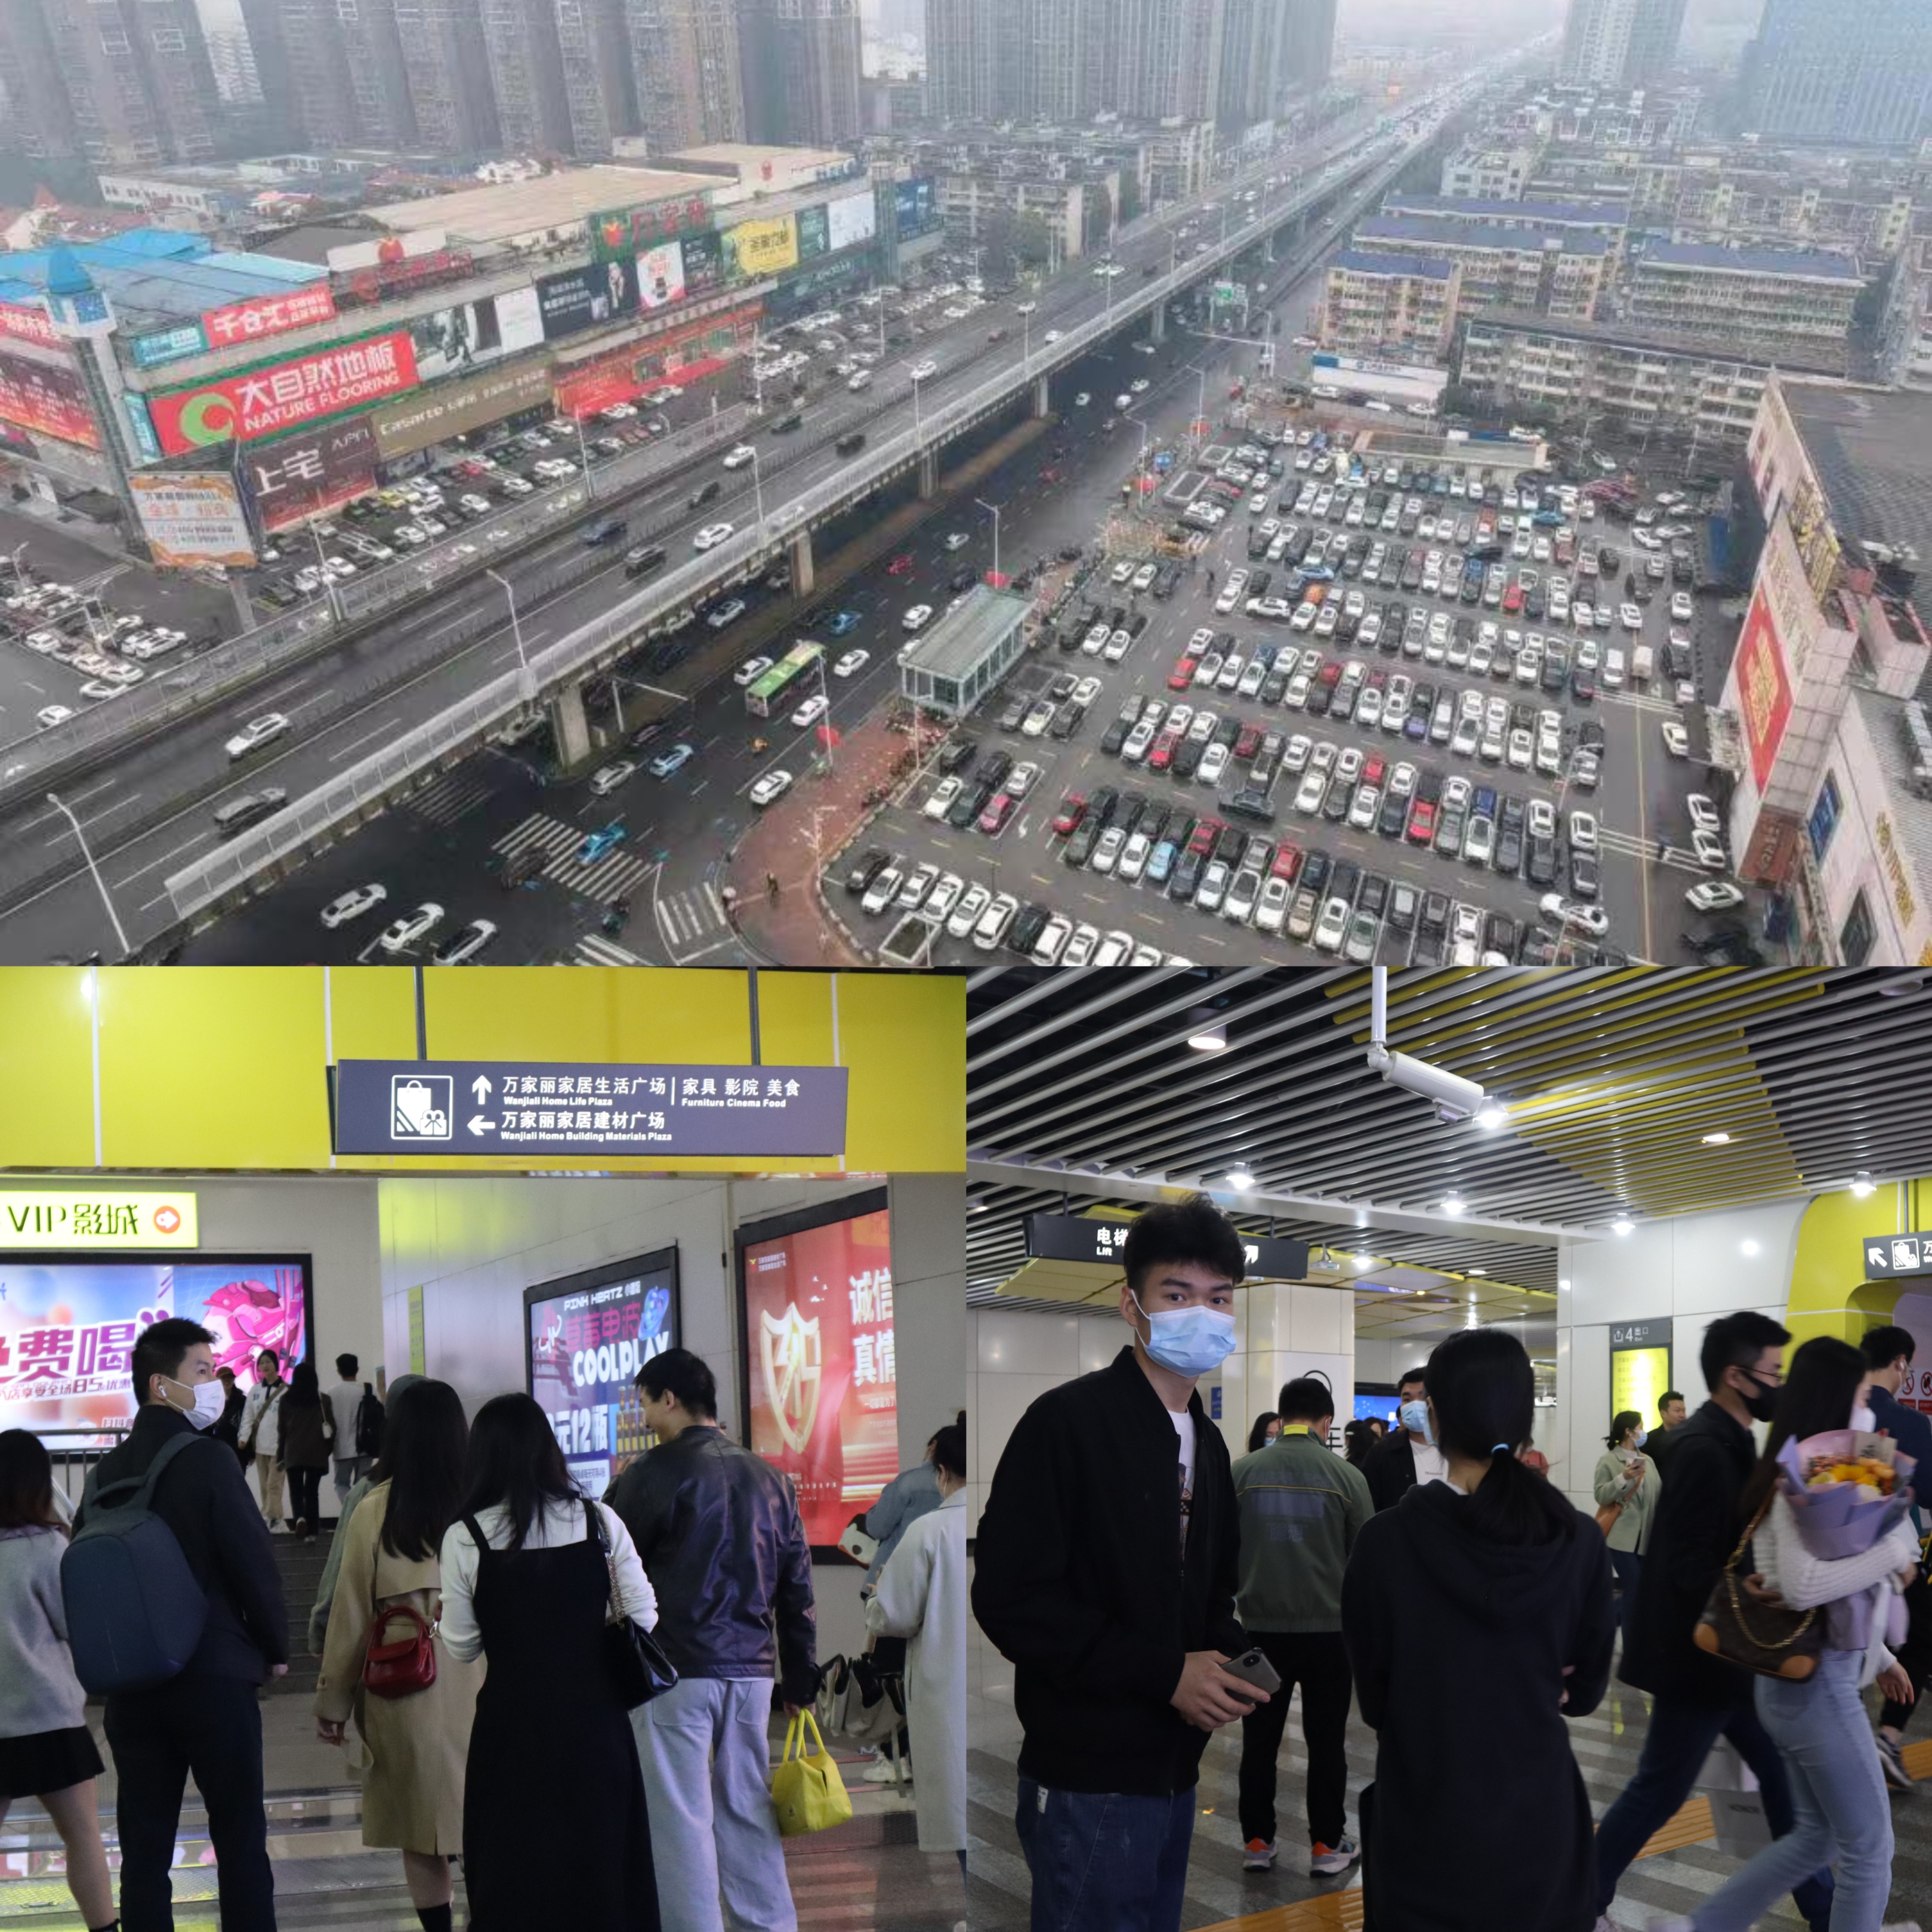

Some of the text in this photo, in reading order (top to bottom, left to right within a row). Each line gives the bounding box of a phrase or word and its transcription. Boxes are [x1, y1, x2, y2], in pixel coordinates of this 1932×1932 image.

[235, 341, 397, 415] 大自然地板
[245, 371, 400, 432] NATURE FLOORING
[502, 1076, 666, 1095] 万家丽家居生活广场
[683, 1078, 800, 1097] 家具 影院 美食
[504, 1097, 613, 1106] Wanjiali Home Life Plaza
[681, 1098, 786, 1107] Furniture Cinema Food
[501, 1111, 665, 1129] 万家丽家居建材广场
[501, 1131, 672, 1142] Wanjiali Home Building Materials Plaza
[7, 1204, 138, 1235] VIP 影城
[1097, 1227, 1129, 1246] 电梯
[1096, 1246, 1113, 1257] Lift
[564, 1295, 589, 1311] PINK
[591, 1286, 623, 1305] HERTZ
[849, 1267, 894, 1325] 诚信
[1625, 1326, 1649, 1342] 4 出口
